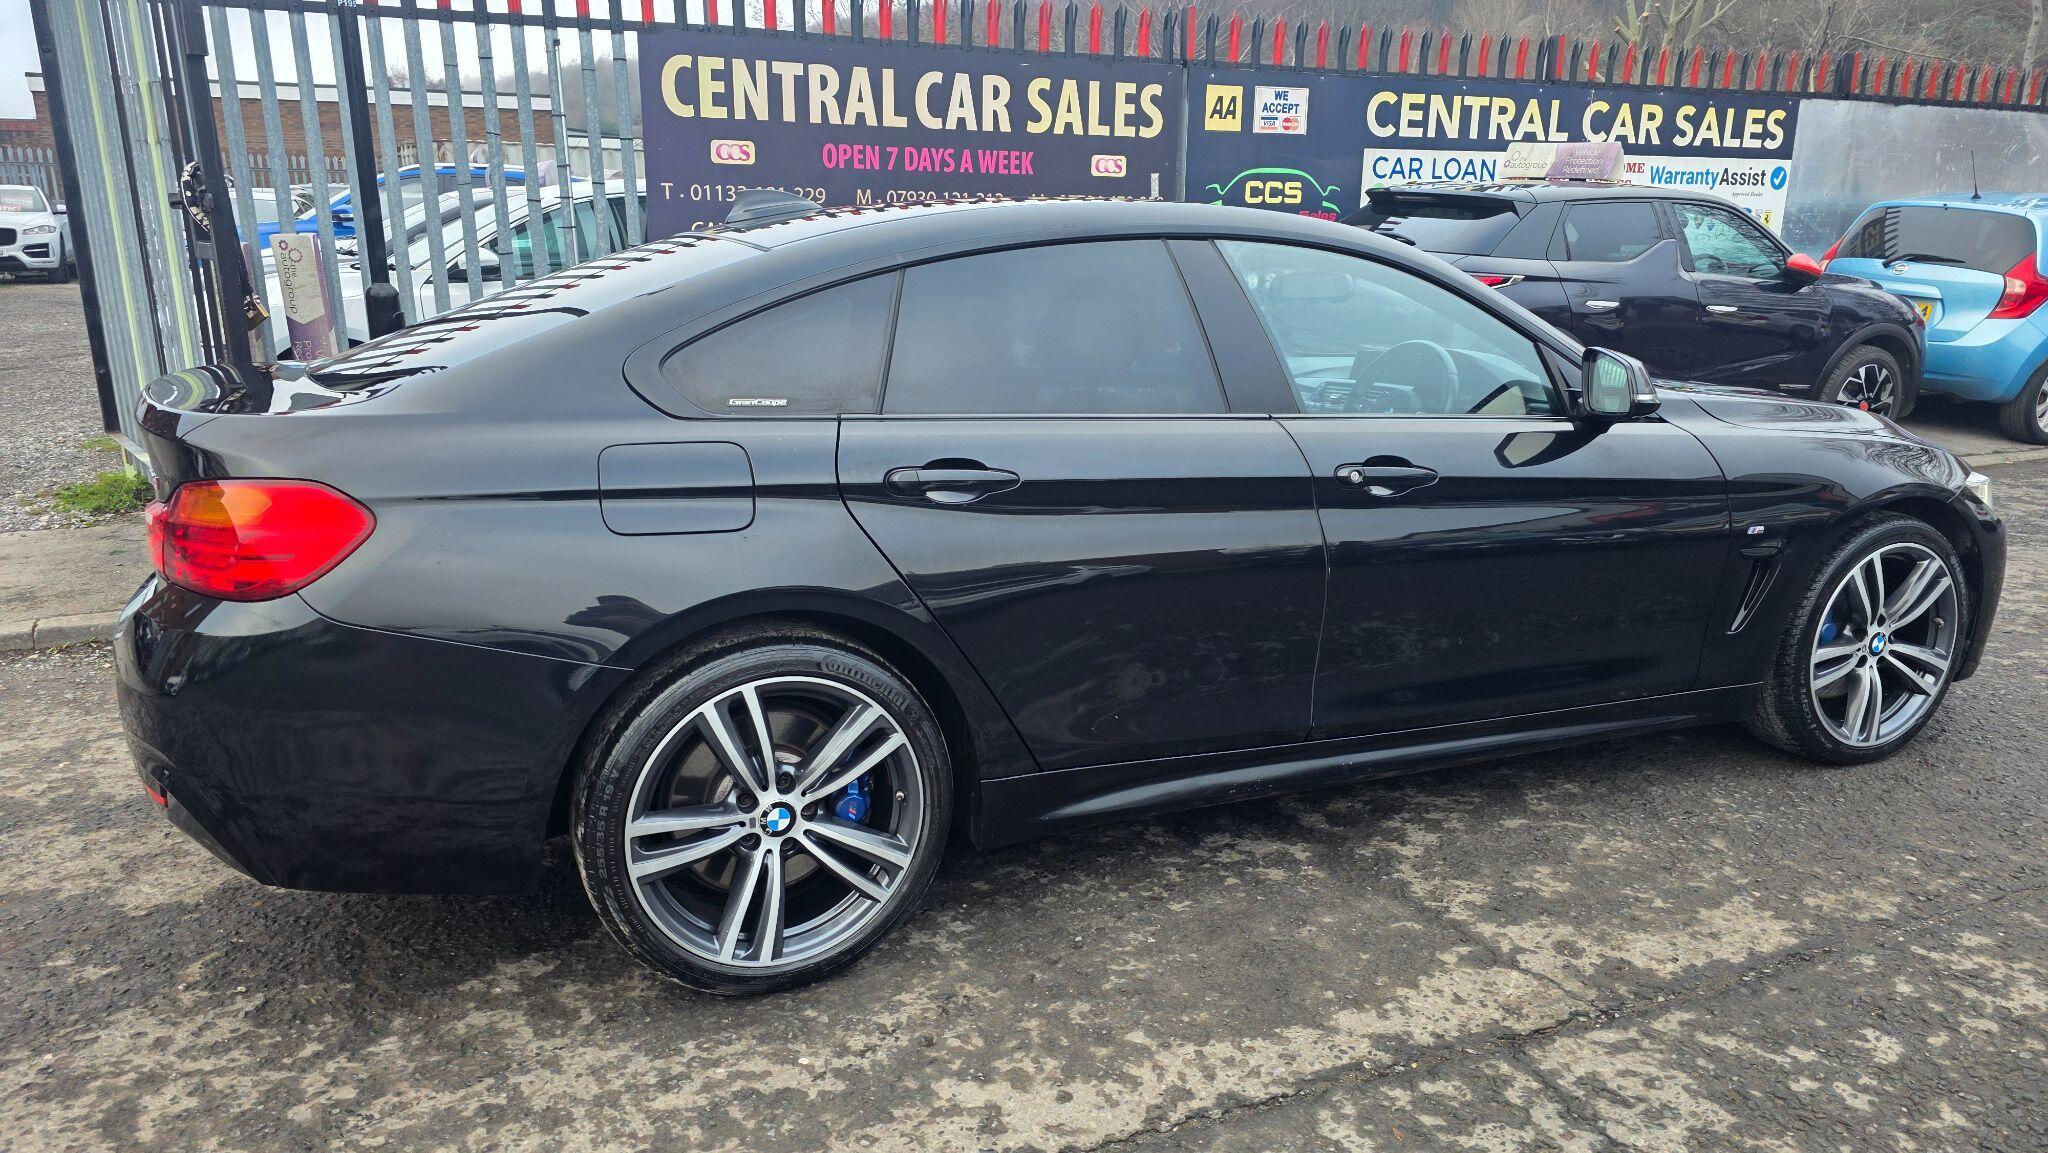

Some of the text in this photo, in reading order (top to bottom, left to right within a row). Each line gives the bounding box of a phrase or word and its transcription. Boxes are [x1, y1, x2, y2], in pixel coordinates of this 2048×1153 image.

[661, 54, 1164, 139] CENTRAL CAR SALES
[1209, 95, 1237, 120] AA
[1274, 90, 1289, 101] WE
[1262, 102, 1300, 115] ACCEPT
[1366, 91, 1787, 150] CENTRAL CAR SALES
[822, 142, 1035, 176] OPEN 7 DAYS A WEEK
[1373, 156, 1497, 182] CAR LOAN
[1509, 161, 1548, 171] autogroup
[1562, 165, 1599, 174] Redefined
[1565, 156, 1604, 165] Protection
[1624, 162, 1645, 173] ME
[1650, 165, 1767, 190] WarrantyAssist
[690, 183, 746, 202] 0113
[1244, 180, 1302, 204] CCS
[280, 252, 298, 315] autogroup
